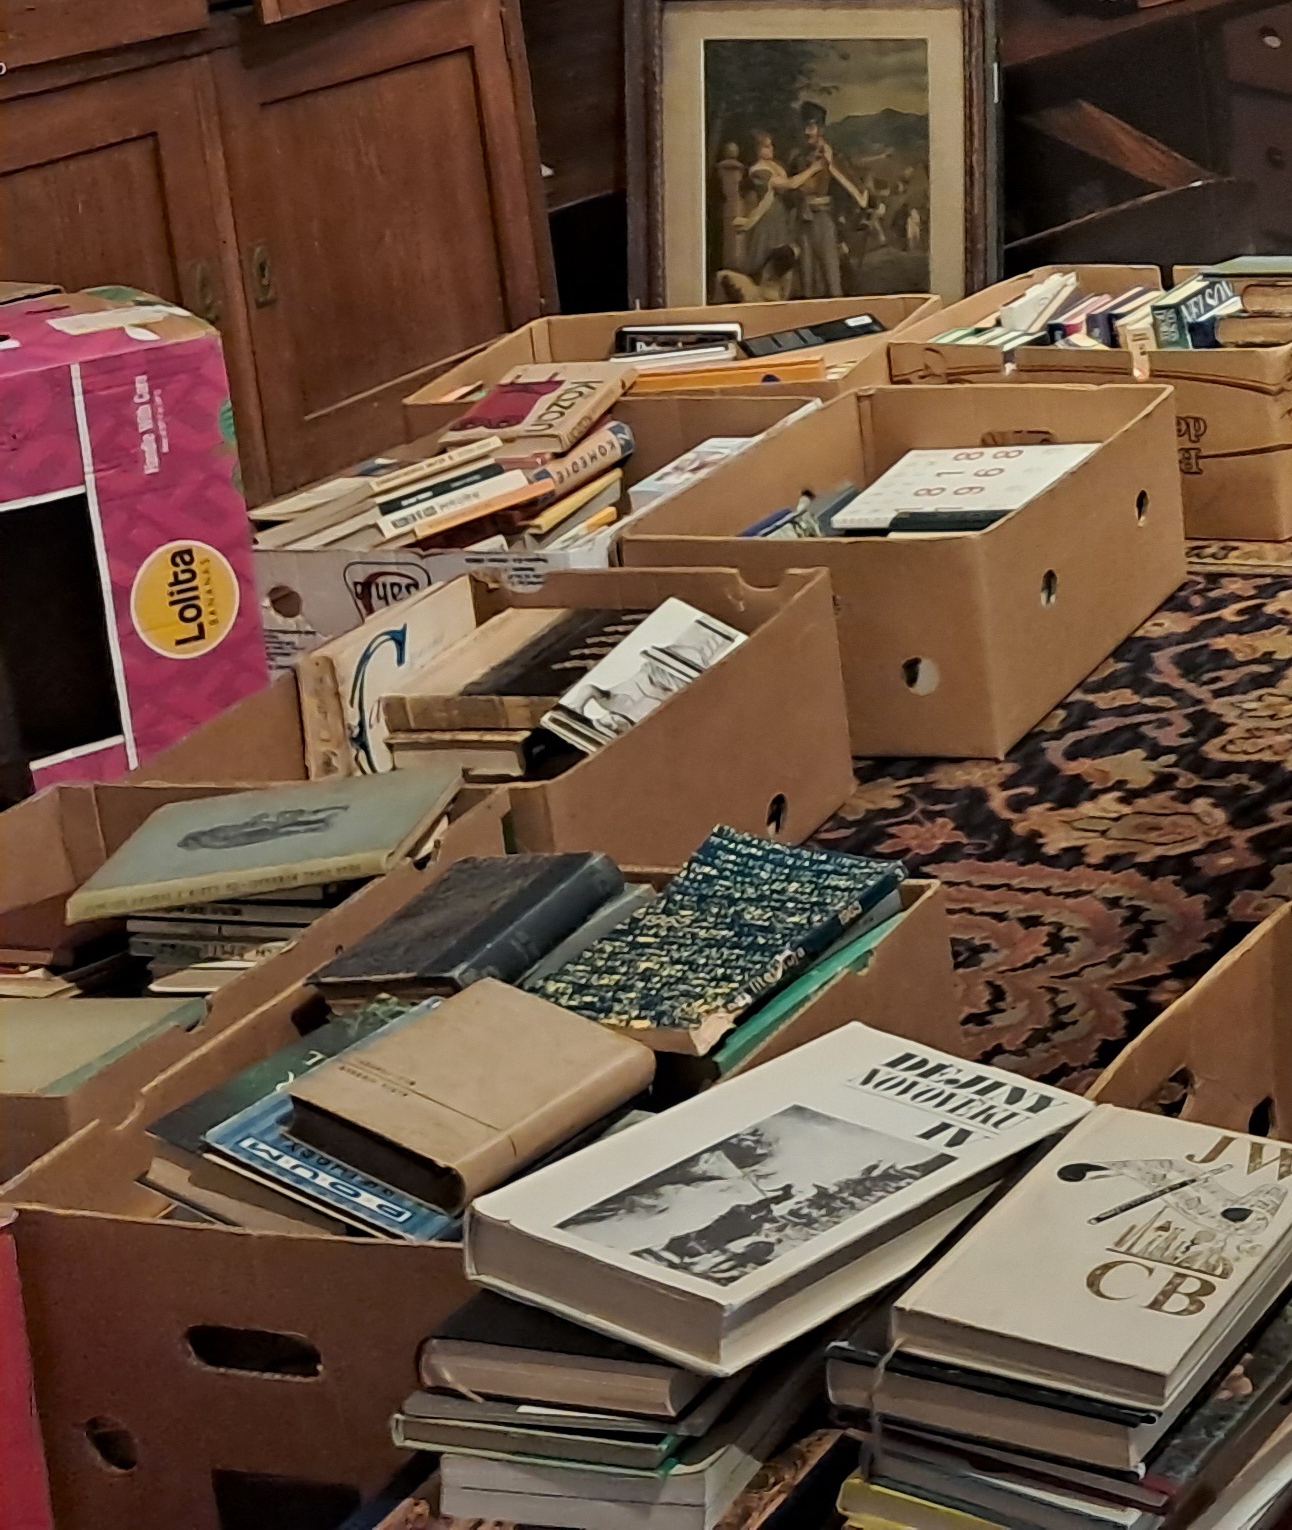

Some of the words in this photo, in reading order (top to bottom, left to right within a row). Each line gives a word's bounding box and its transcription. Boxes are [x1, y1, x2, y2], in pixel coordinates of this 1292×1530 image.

[175, 547, 206, 648] Lolita
[881, 1051, 1070, 1115] DĚJINY
[914, 1120, 994, 1149] IV
[1084, 1259, 1218, 1318] CB
